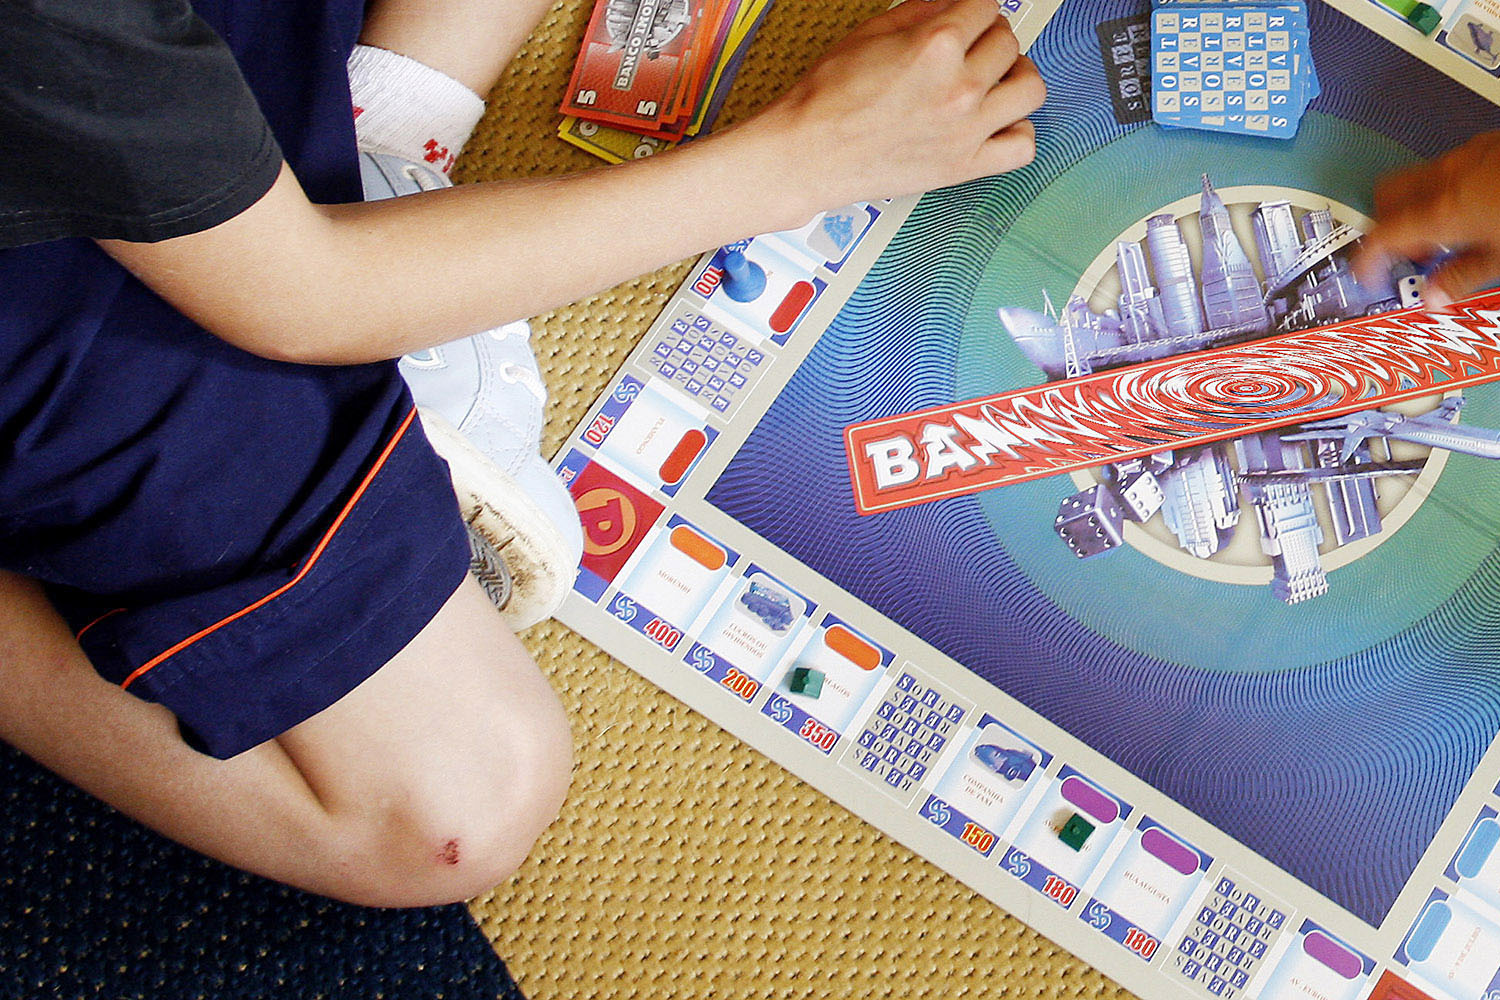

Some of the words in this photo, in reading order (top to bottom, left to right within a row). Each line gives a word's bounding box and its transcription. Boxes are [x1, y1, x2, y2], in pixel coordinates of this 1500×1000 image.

[617, 36, 642, 87] BANCO
[1161, 18, 1175, 105] SORTE
[1183, 17, 1197, 105] REVES
[1206, 18, 1219, 104] SORTE
[1226, 16, 1241, 104] REVES
[1250, 17, 1263, 103] SORTE
[1270, 15, 1285, 103] REVES
[577, 88, 596, 106] 5
[638, 98, 656, 116] 5
[695, 266, 721, 295] 100
[586, 413, 613, 442] 120
[644, 617, 679, 647] 400
[722, 669, 756, 699] 200
[799, 718, 835, 749] 350
[962, 774, 1004, 803] COMPANHIA
[960, 823, 993, 851] 150
[1042, 876, 1074, 904] 180
[1122, 927, 1155, 957] 180
